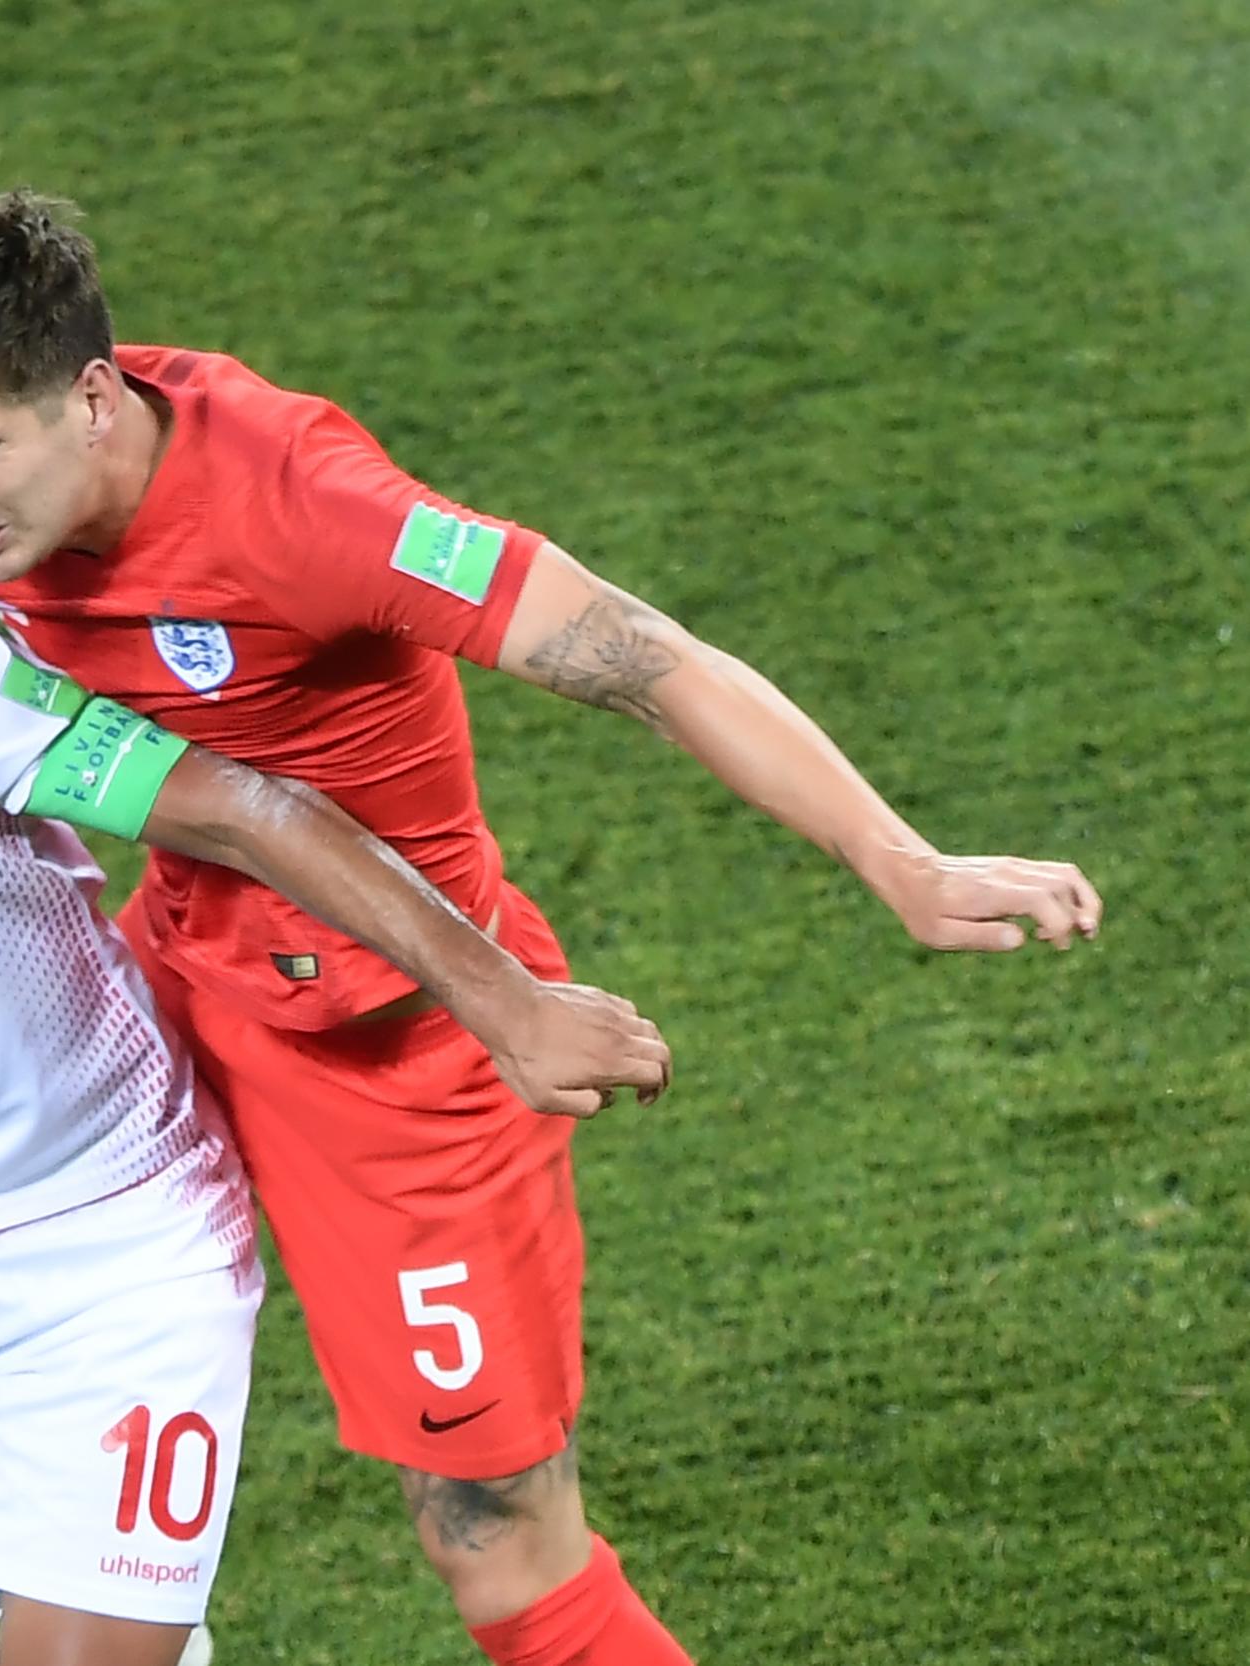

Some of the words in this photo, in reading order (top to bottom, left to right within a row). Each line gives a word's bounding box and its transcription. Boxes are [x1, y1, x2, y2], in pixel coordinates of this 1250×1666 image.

[398, 1261, 483, 1390] 5
[100, 1405, 217, 1541] 10
[101, 1554, 199, 1586] uhlsport
